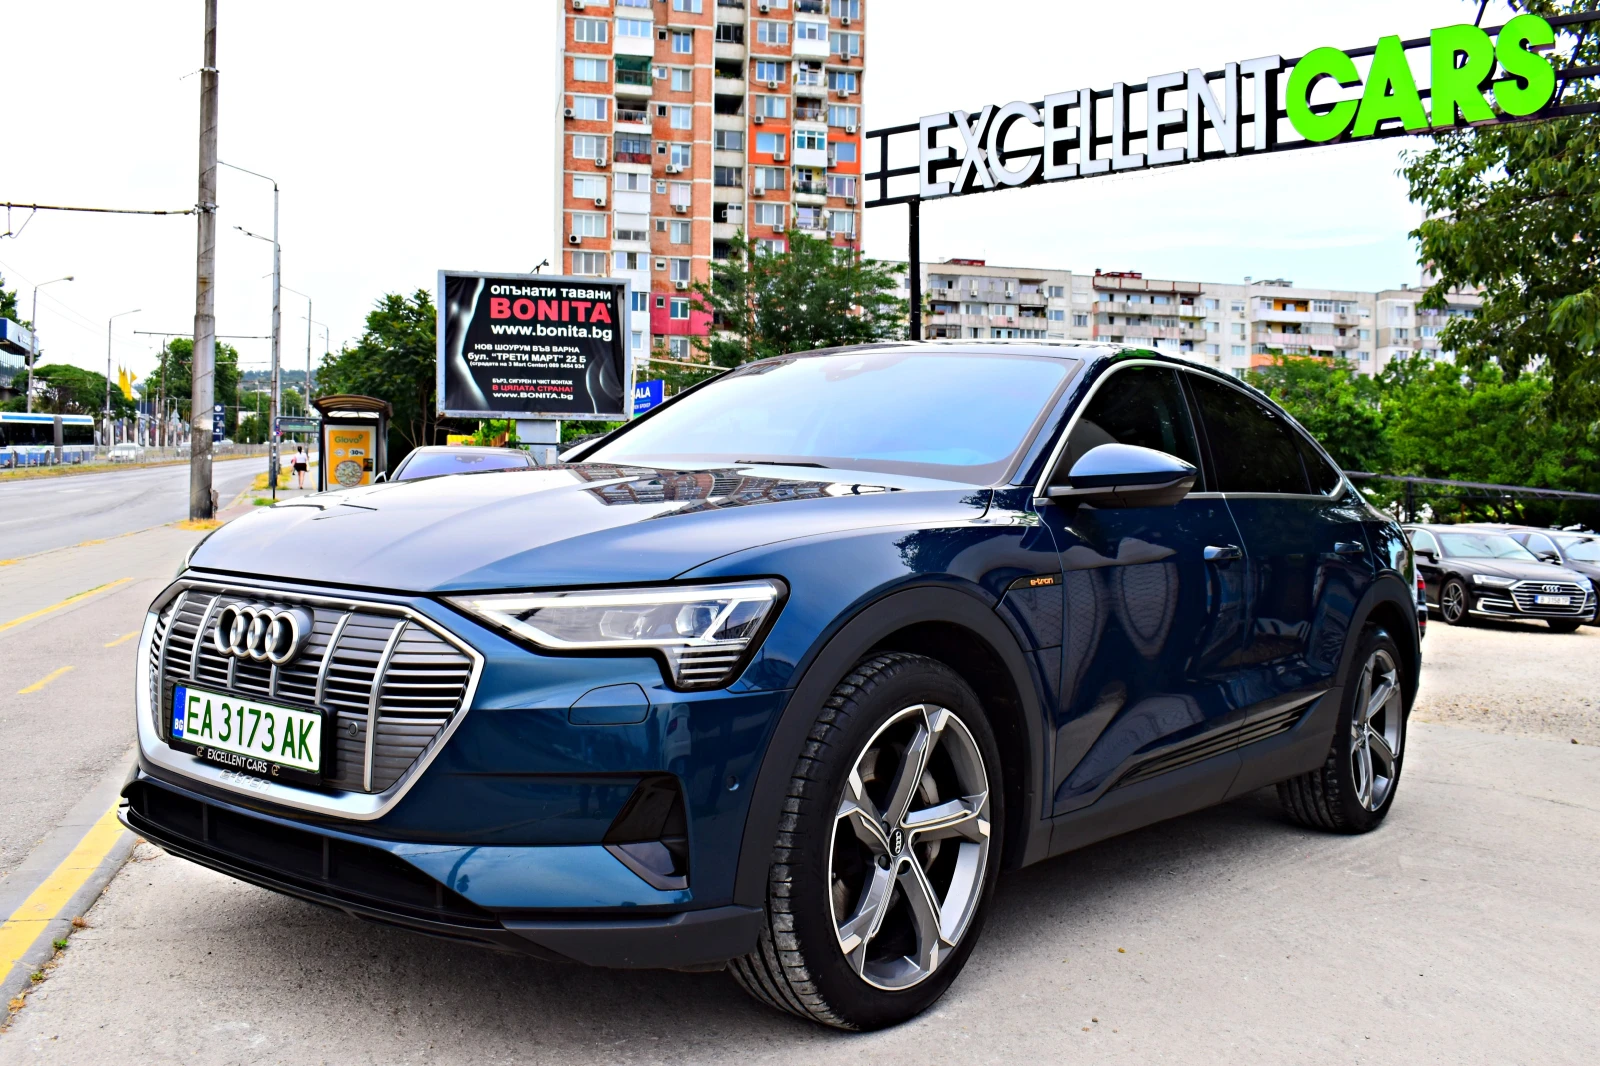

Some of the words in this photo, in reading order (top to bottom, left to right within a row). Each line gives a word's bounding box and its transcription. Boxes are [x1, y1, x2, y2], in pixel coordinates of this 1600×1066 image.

[919, 55, 1283, 199] EXCELLENT
[1285, 14, 1556, 142] CARS
[490, 284, 556, 297] опънати
[560, 287, 611, 300] тавани
[490, 297, 611, 324] BONITA
[491, 324, 612, 342] www.bonita.bg
[494, 344, 531, 352] ШОУРУМ
[552, 345, 580, 353] ВАРНА
[467, 352, 489, 361] бул.
[565, 355, 579, 363] 22
[579, 355, 587, 363] Б
[501, 384, 535, 392] ЦЯЛАТА
[493, 392, 574, 400] www.BONITA.bg
[335, 435, 361, 444] Glovo
[1030, 577, 1053, 585] e-tron
[174, 717, 183, 730] BG
[187, 695, 213, 739] EA
[218, 702, 275, 752] 3173
[281, 716, 315, 762] AK
[207, 749, 247, 768] EXCELLENT
[246, 759, 268, 773] CARS
[219, 769, 272, 792] e-tron
